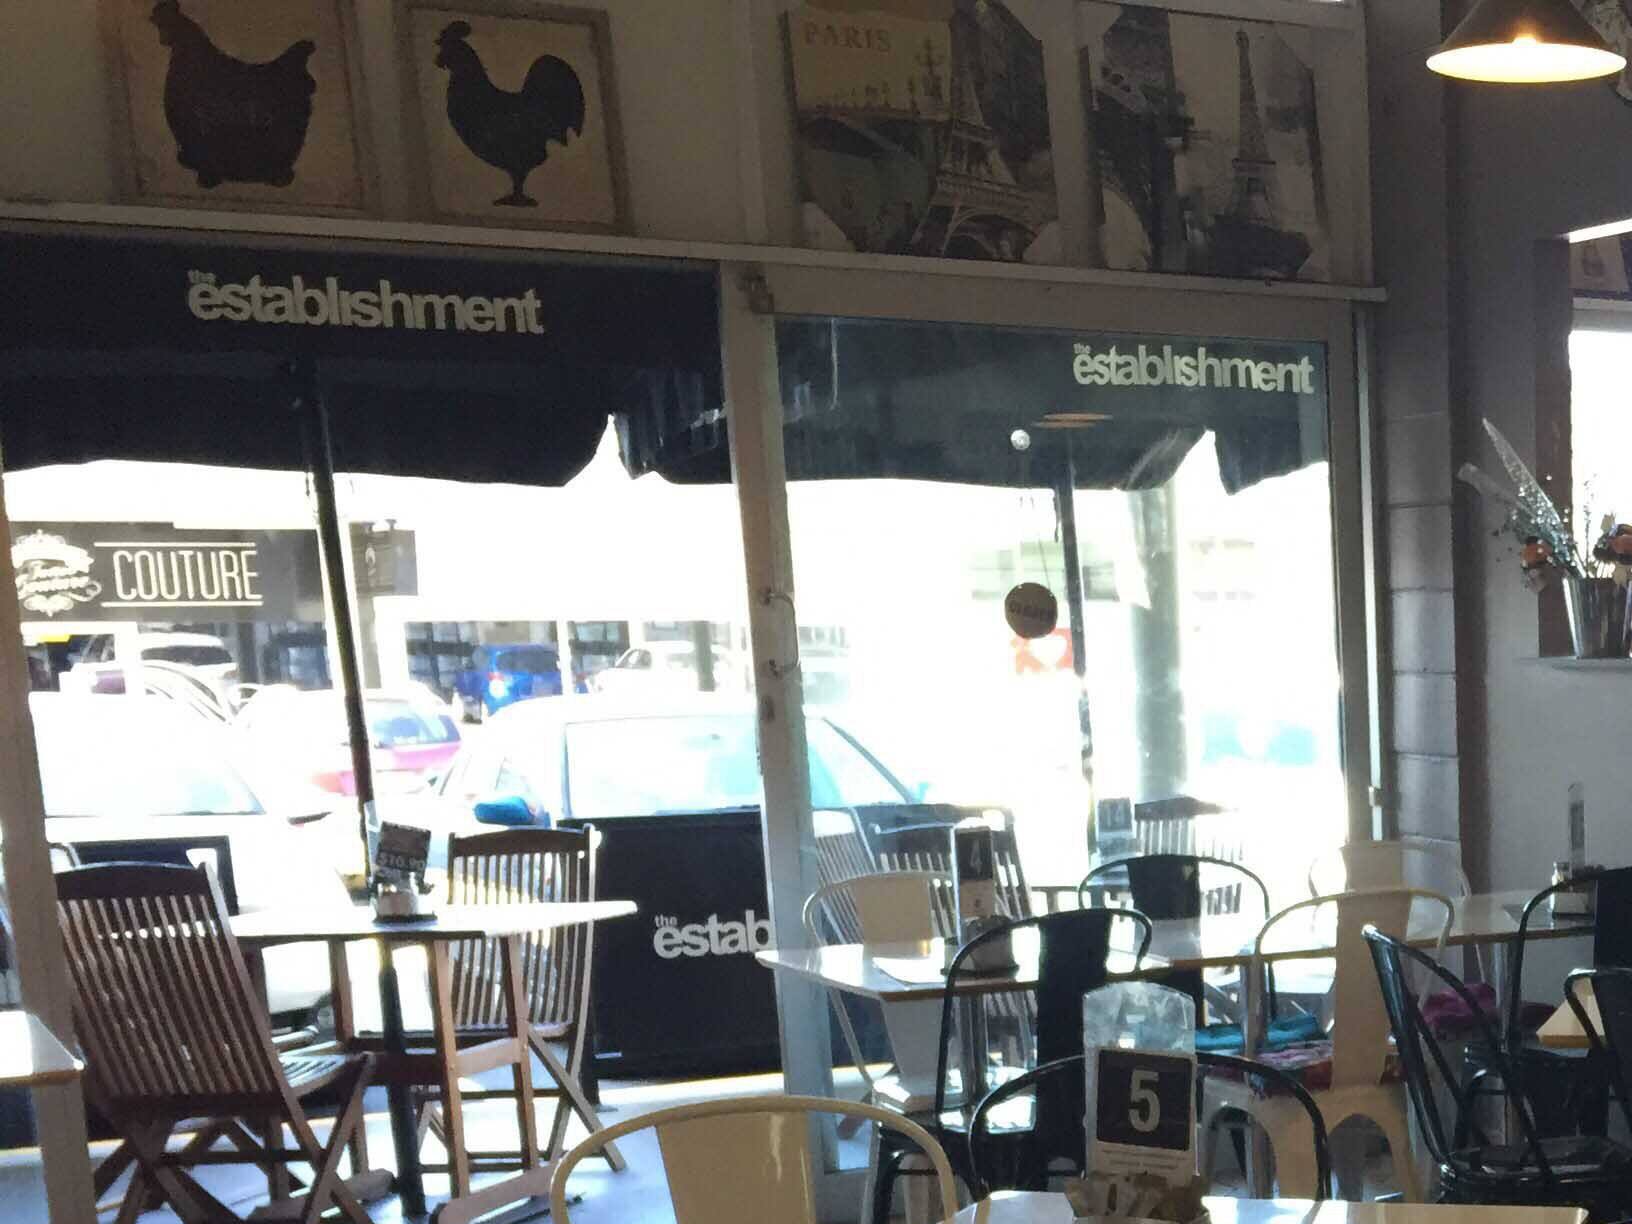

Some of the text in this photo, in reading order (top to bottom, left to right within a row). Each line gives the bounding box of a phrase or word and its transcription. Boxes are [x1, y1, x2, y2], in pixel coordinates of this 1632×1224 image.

[804, 22, 892, 53] PARIS
[188, 274, 545, 334] establishment
[1073, 343, 1092, 354] the
[1073, 344, 1315, 394] establishment
[113, 550, 263, 600] COUTURE
[970, 839, 983, 874] 4
[654, 913, 678, 928] the
[1127, 1069, 1161, 1132] 5
